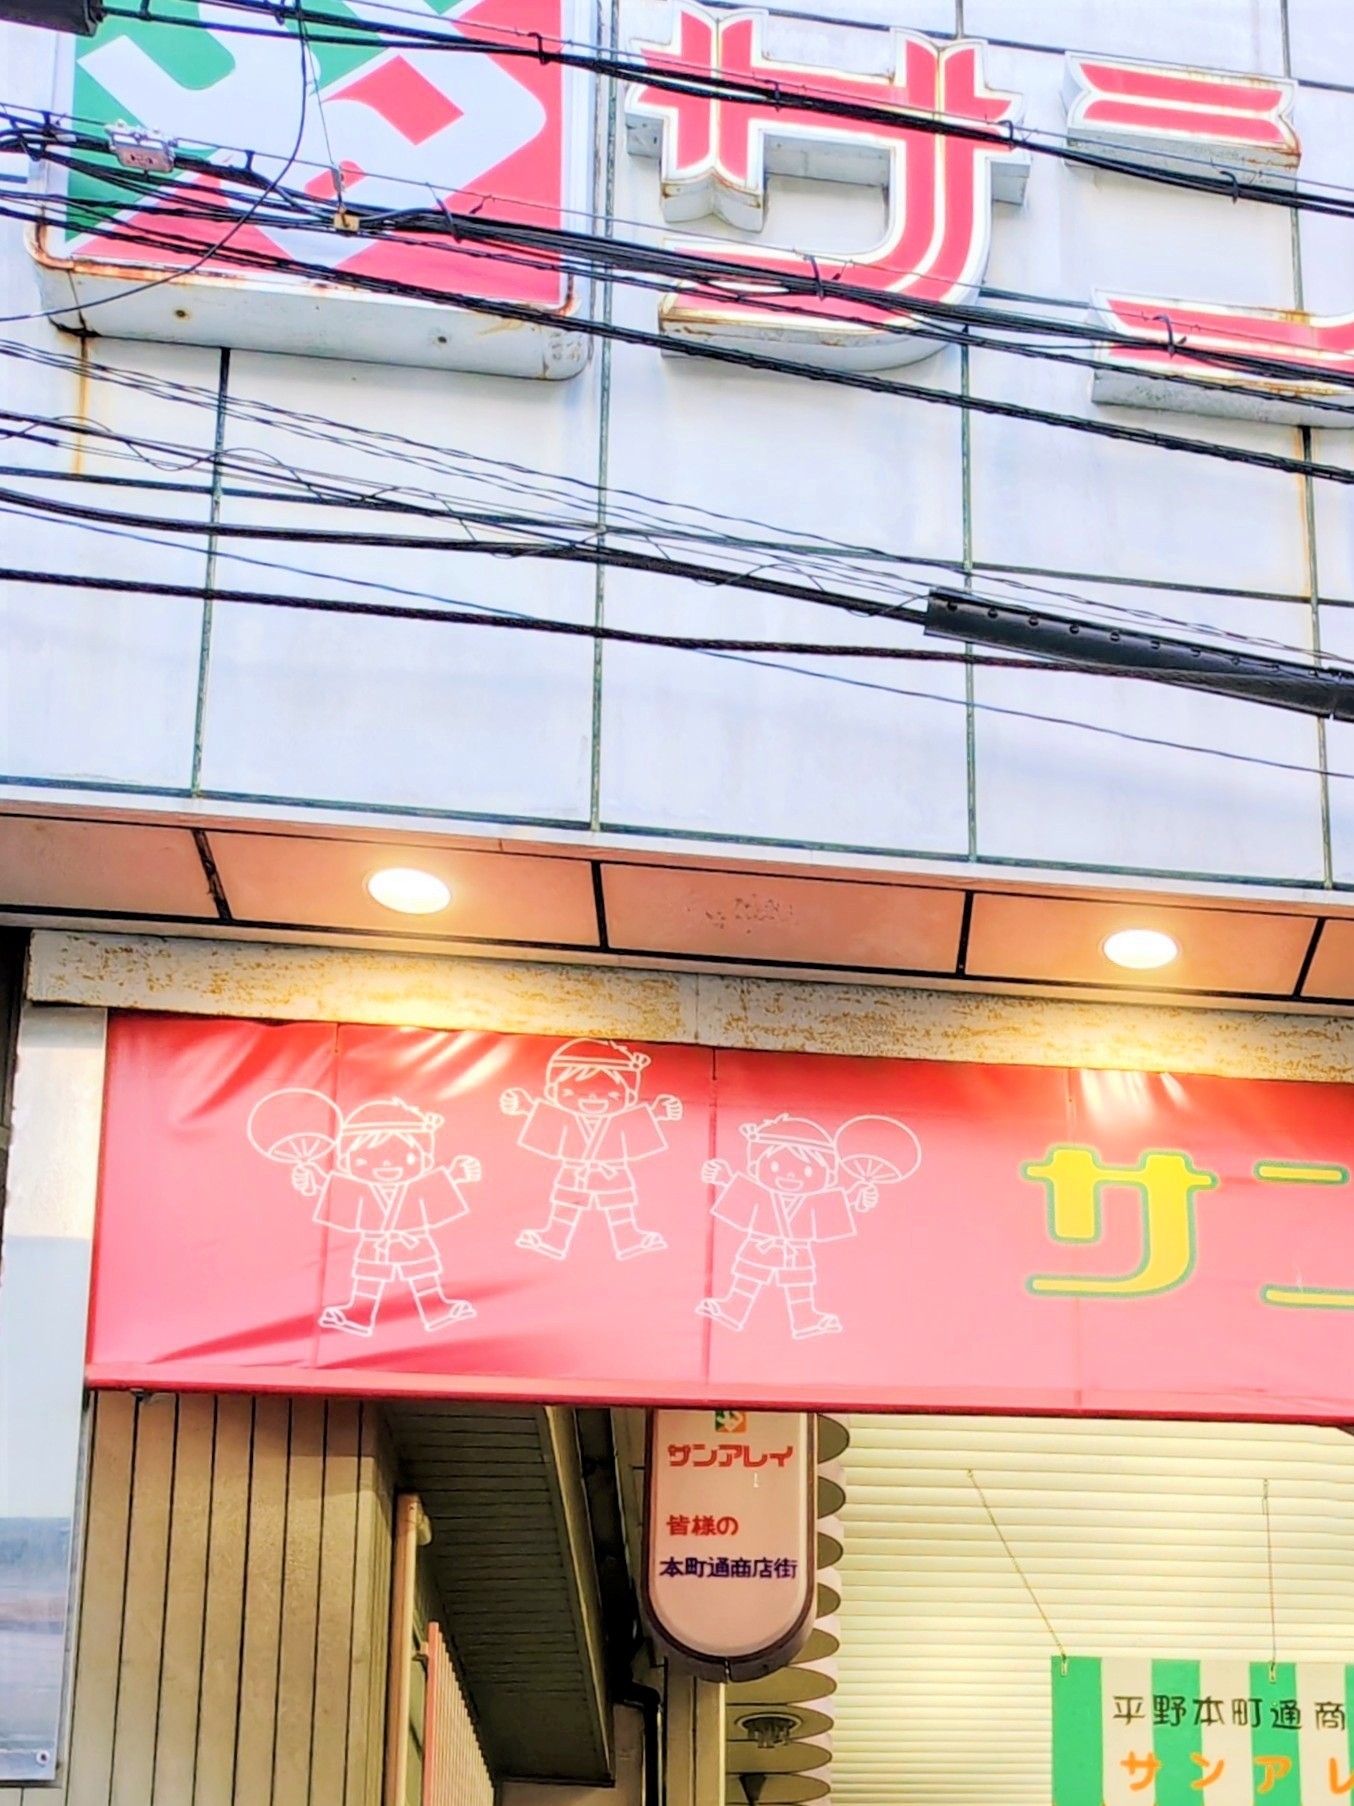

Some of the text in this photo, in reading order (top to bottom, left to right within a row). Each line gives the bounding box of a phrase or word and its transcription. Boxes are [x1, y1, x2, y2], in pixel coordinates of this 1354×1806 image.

[667, 1444, 794, 1468] サンアレイ
[666, 1514, 740, 1537] 皆様の
[659, 1556, 798, 1579] 本町通商店街
